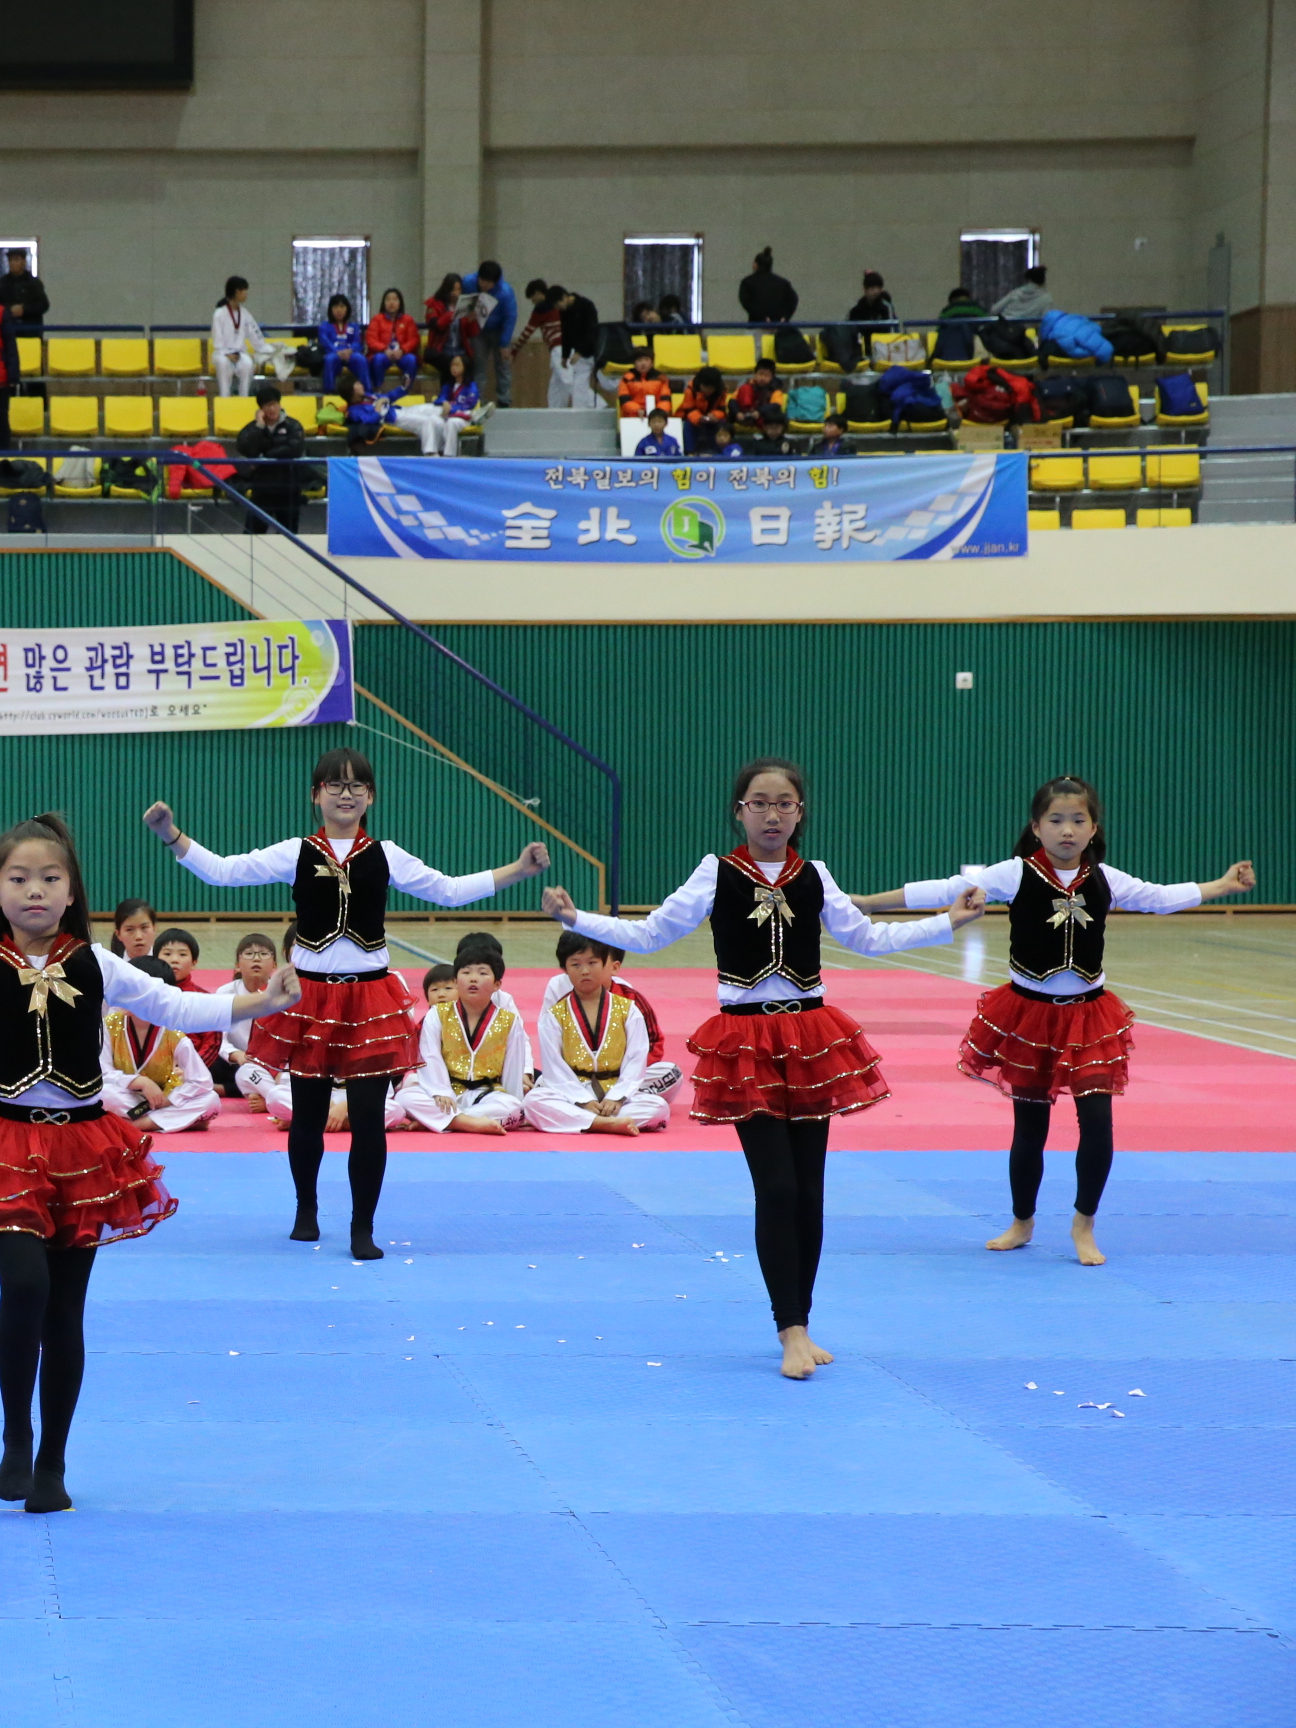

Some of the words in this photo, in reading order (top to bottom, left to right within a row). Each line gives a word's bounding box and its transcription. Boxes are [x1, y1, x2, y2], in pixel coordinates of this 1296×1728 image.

[544, 465, 659, 490] 전북일보의
[671, 466, 716, 491] 힘이
[727, 465, 797, 490] 전북의
[807, 465, 840, 490] 힘!
[950, 541, 1020, 555] www.jjan.kr
[23, 643, 71, 693] 많은
[84, 641, 134, 692] 관람
[146, 635, 308, 692] 부탁드립니다.
